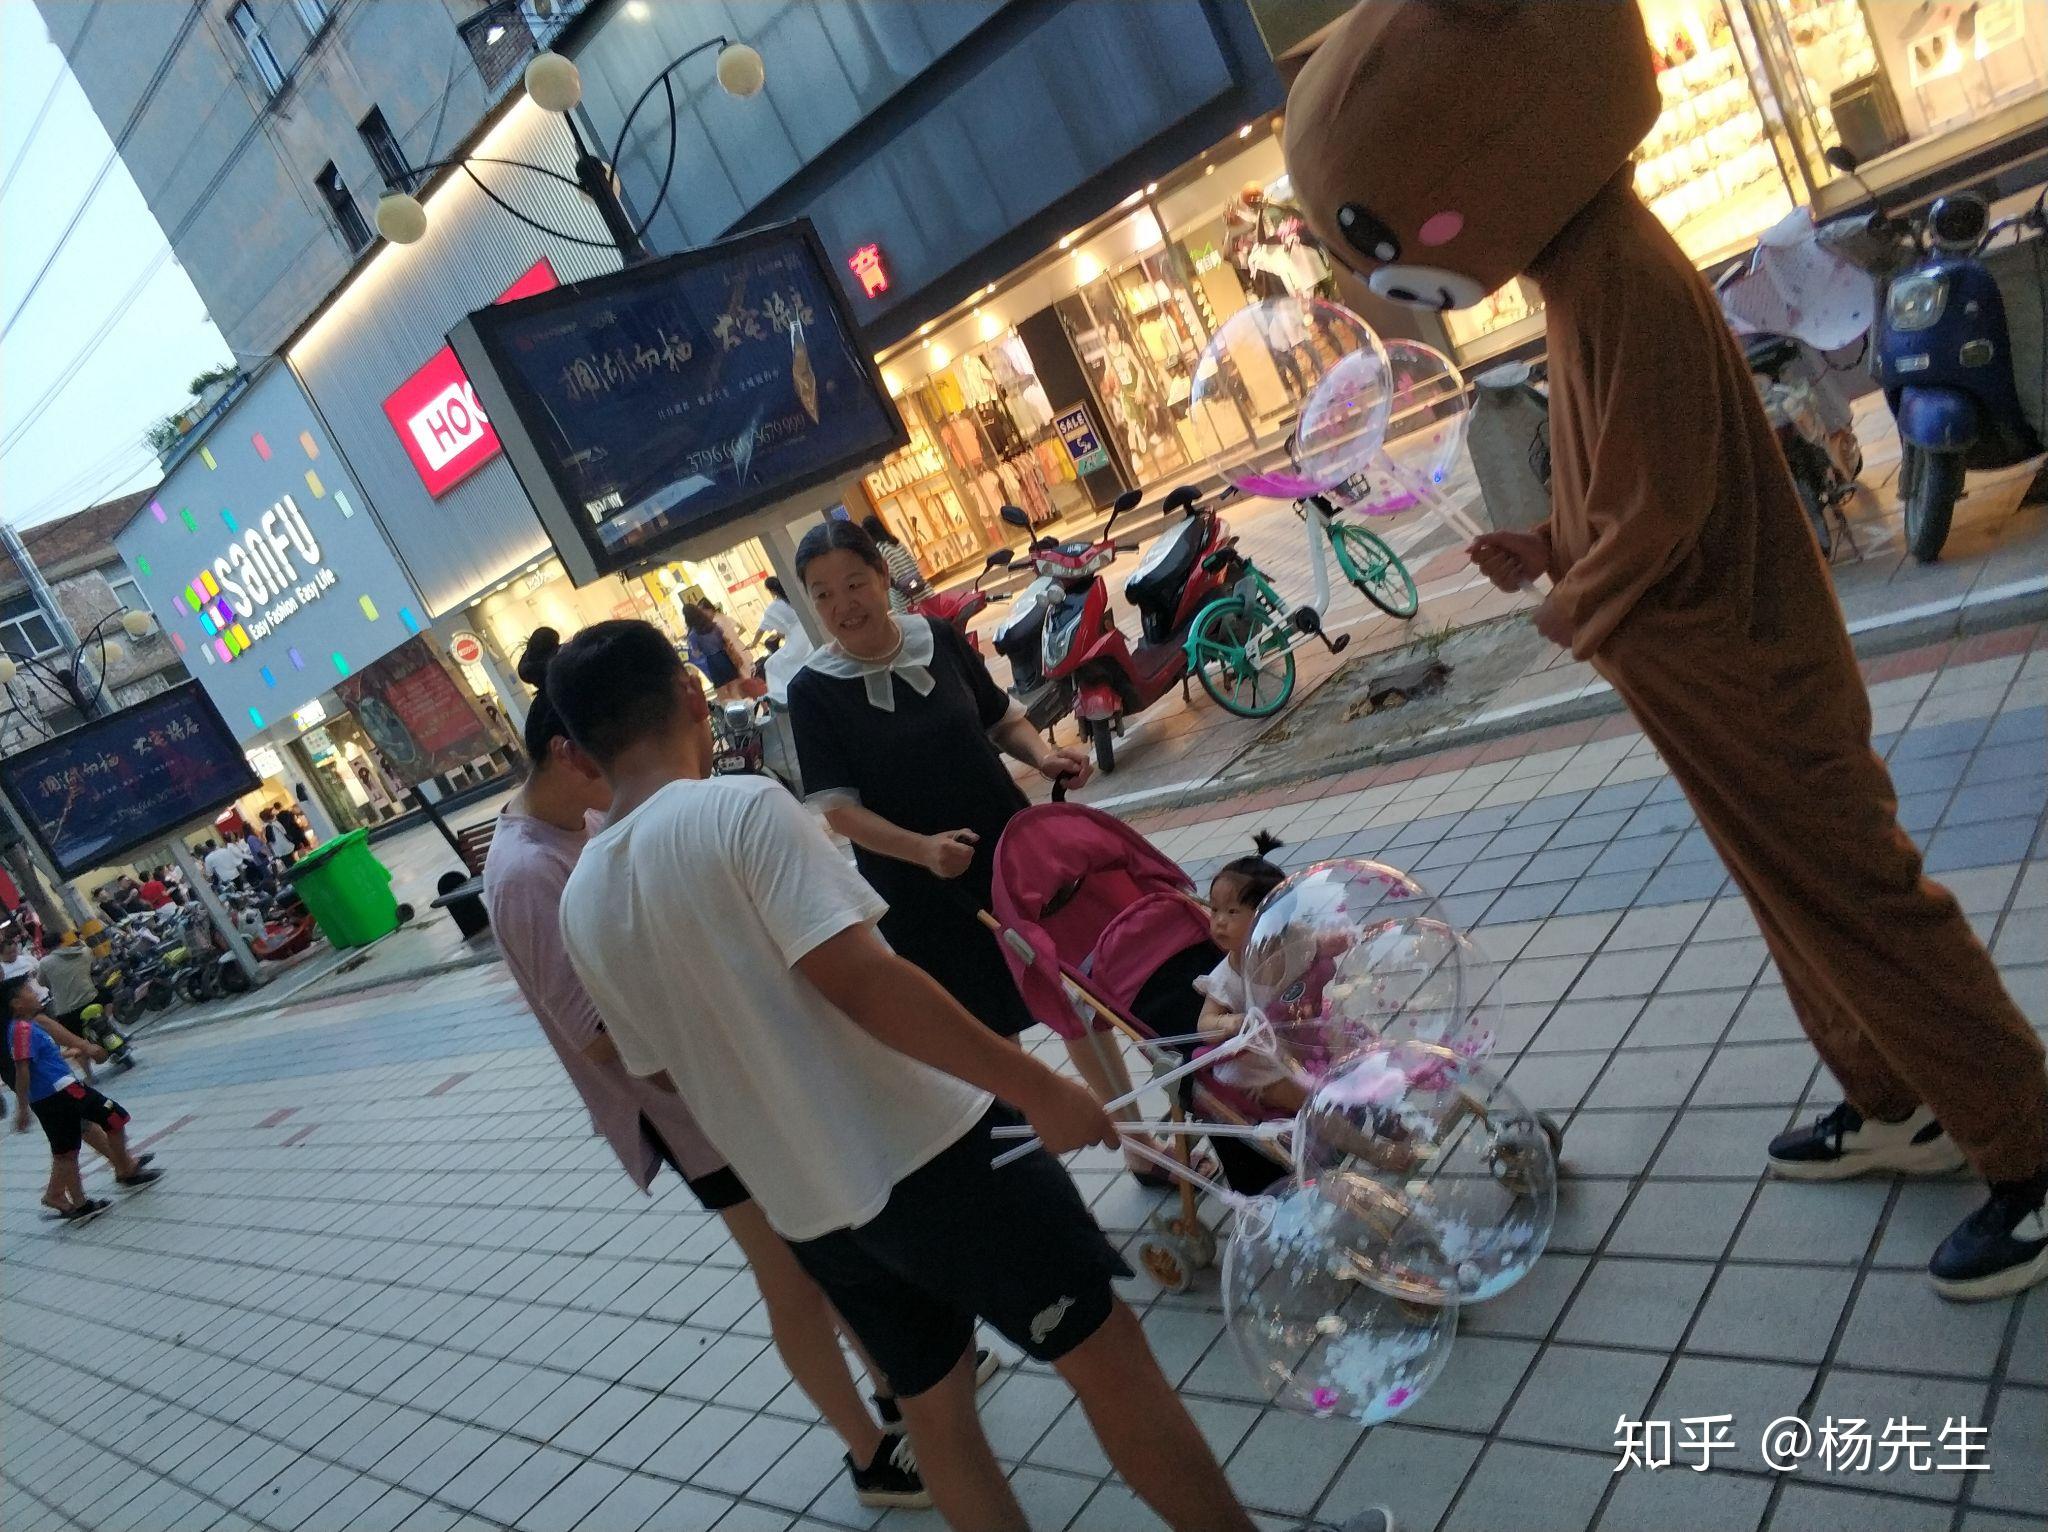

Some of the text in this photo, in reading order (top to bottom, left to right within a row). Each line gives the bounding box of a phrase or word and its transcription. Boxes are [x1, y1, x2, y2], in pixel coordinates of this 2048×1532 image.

[1060, 412, 1085, 434] SALE
[248, 567, 337, 641] Easy Fashion Easy Life
